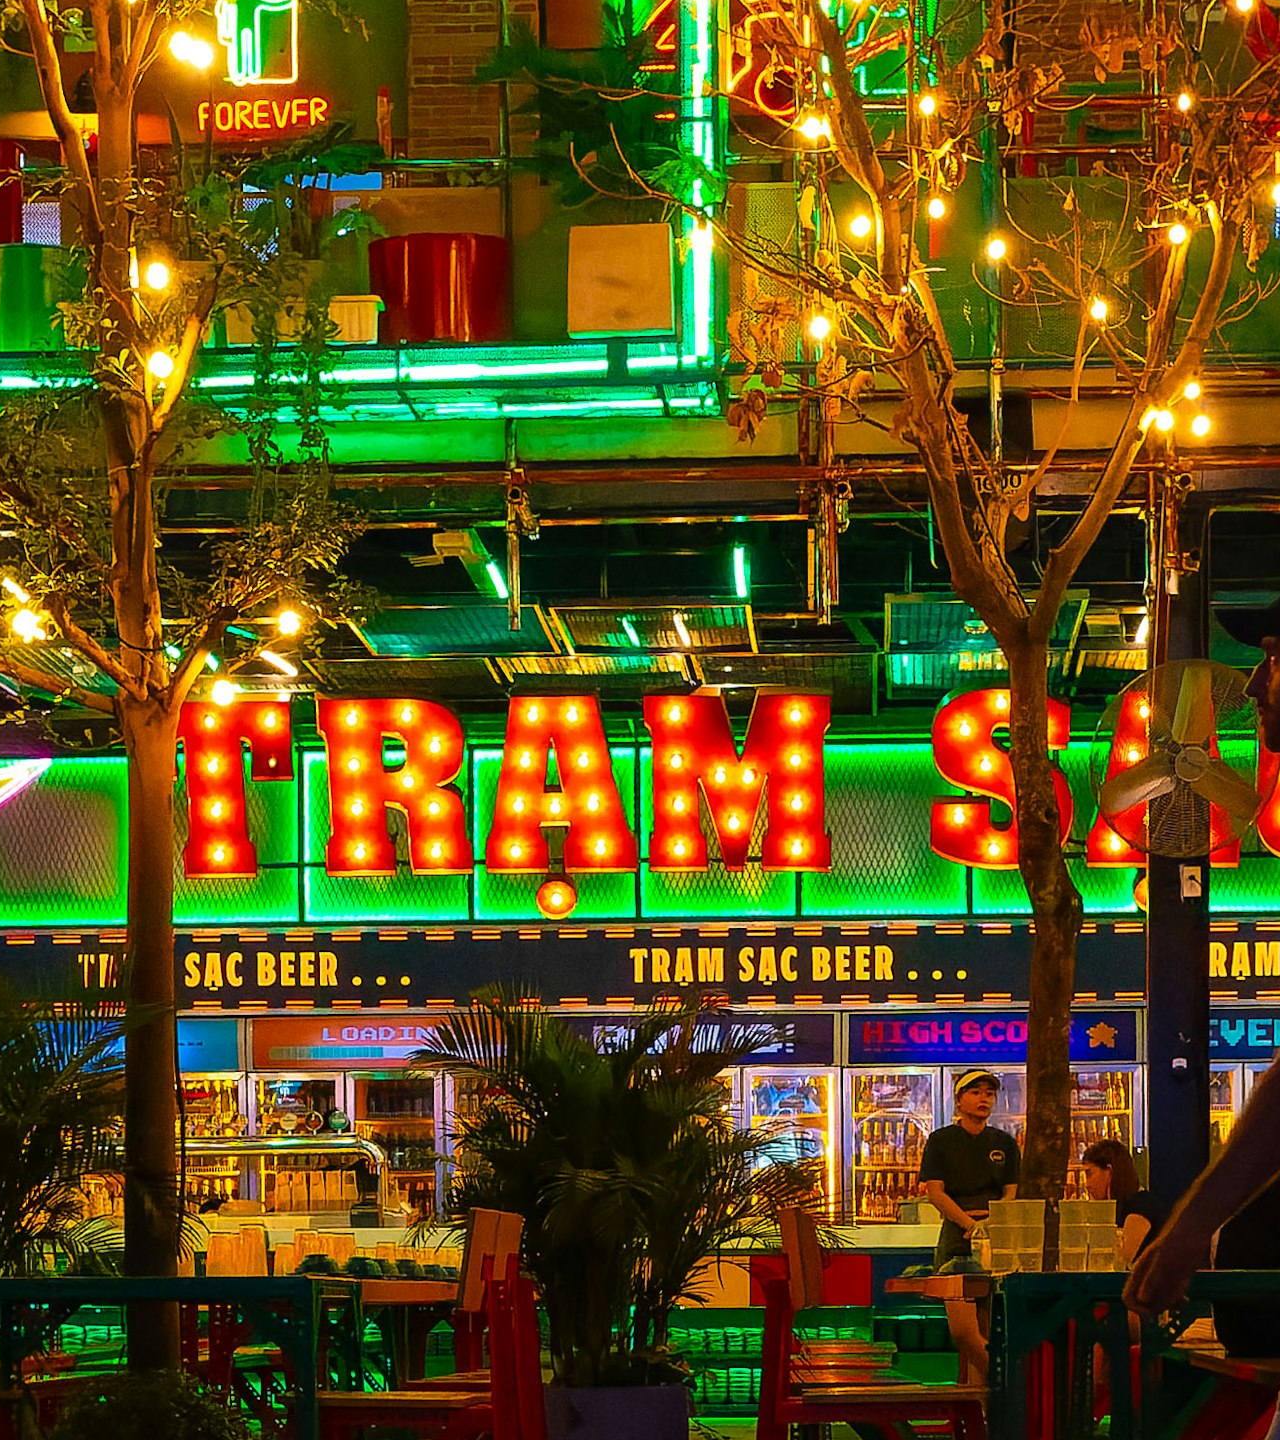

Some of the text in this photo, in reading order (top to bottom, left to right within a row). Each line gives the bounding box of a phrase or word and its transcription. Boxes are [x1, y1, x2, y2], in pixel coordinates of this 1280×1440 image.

[183, 951, 243, 992] SẠC
[256, 950, 339, 988] BEER
[629, 945, 725, 987] TRẠM
[738, 946, 799, 986] SẠC
[811, 944, 895, 982] BEER
[863, 1019, 953, 1045] HIGH
